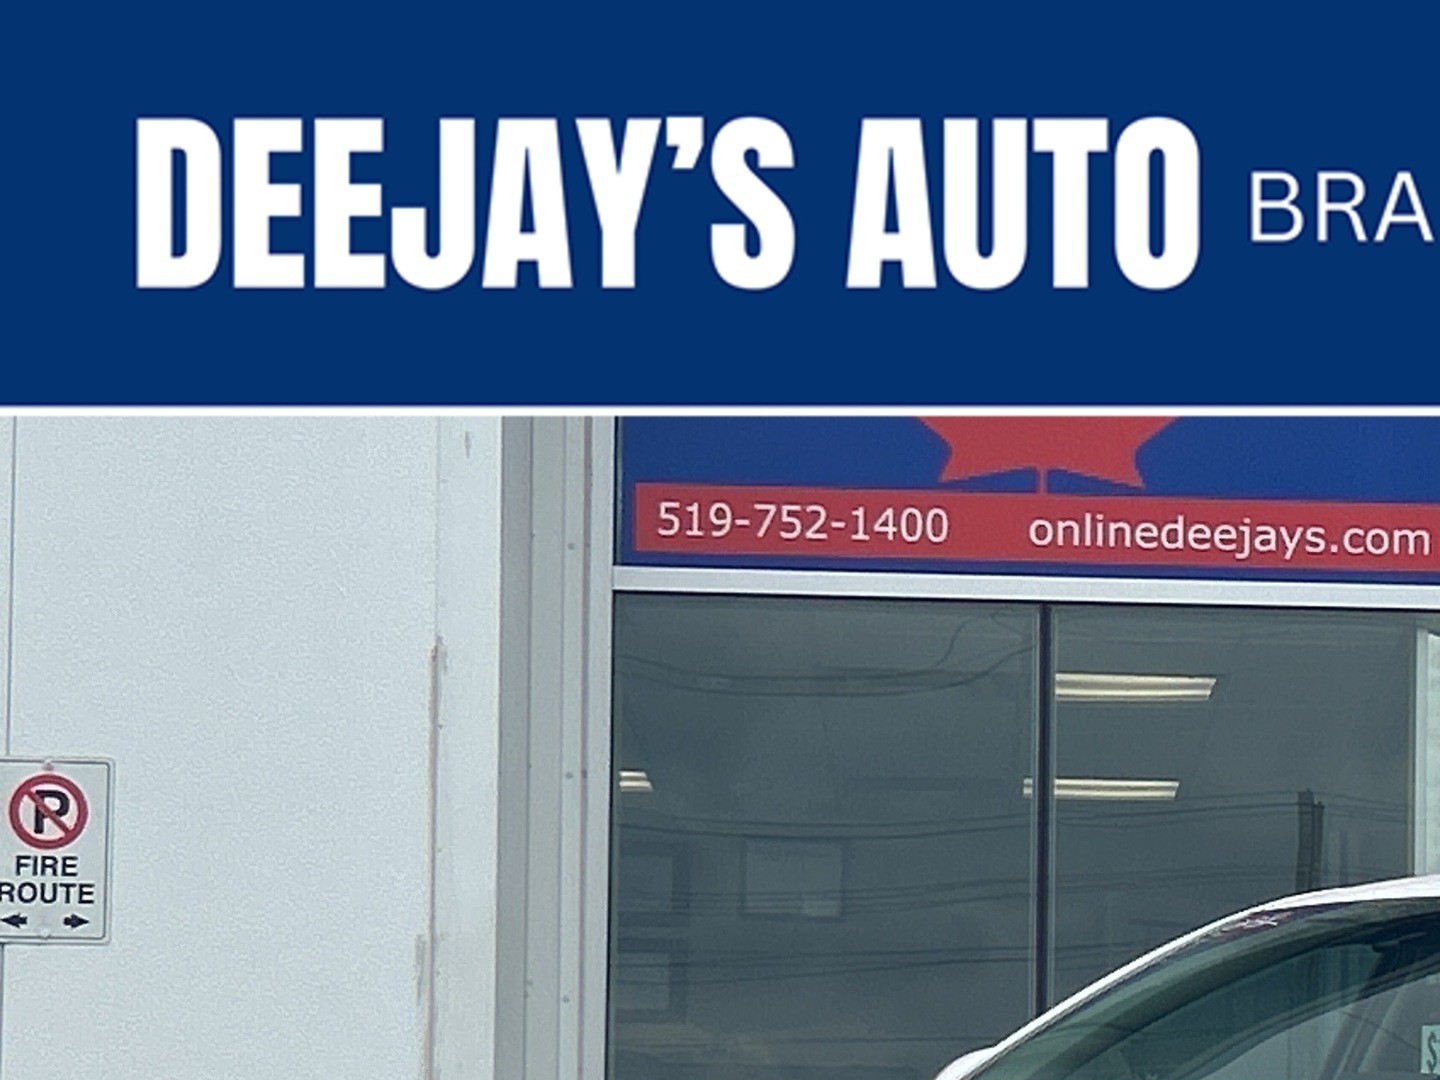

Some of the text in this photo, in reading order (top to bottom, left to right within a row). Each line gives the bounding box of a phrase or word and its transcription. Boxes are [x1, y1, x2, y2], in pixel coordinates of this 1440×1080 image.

[657, 501, 949, 543] 519-752-1400
[1029, 512, 1430, 560] onlinedeejays.com
[15, 854, 79, 877] FIRE
[0, 881, 96, 905] ROUTE
